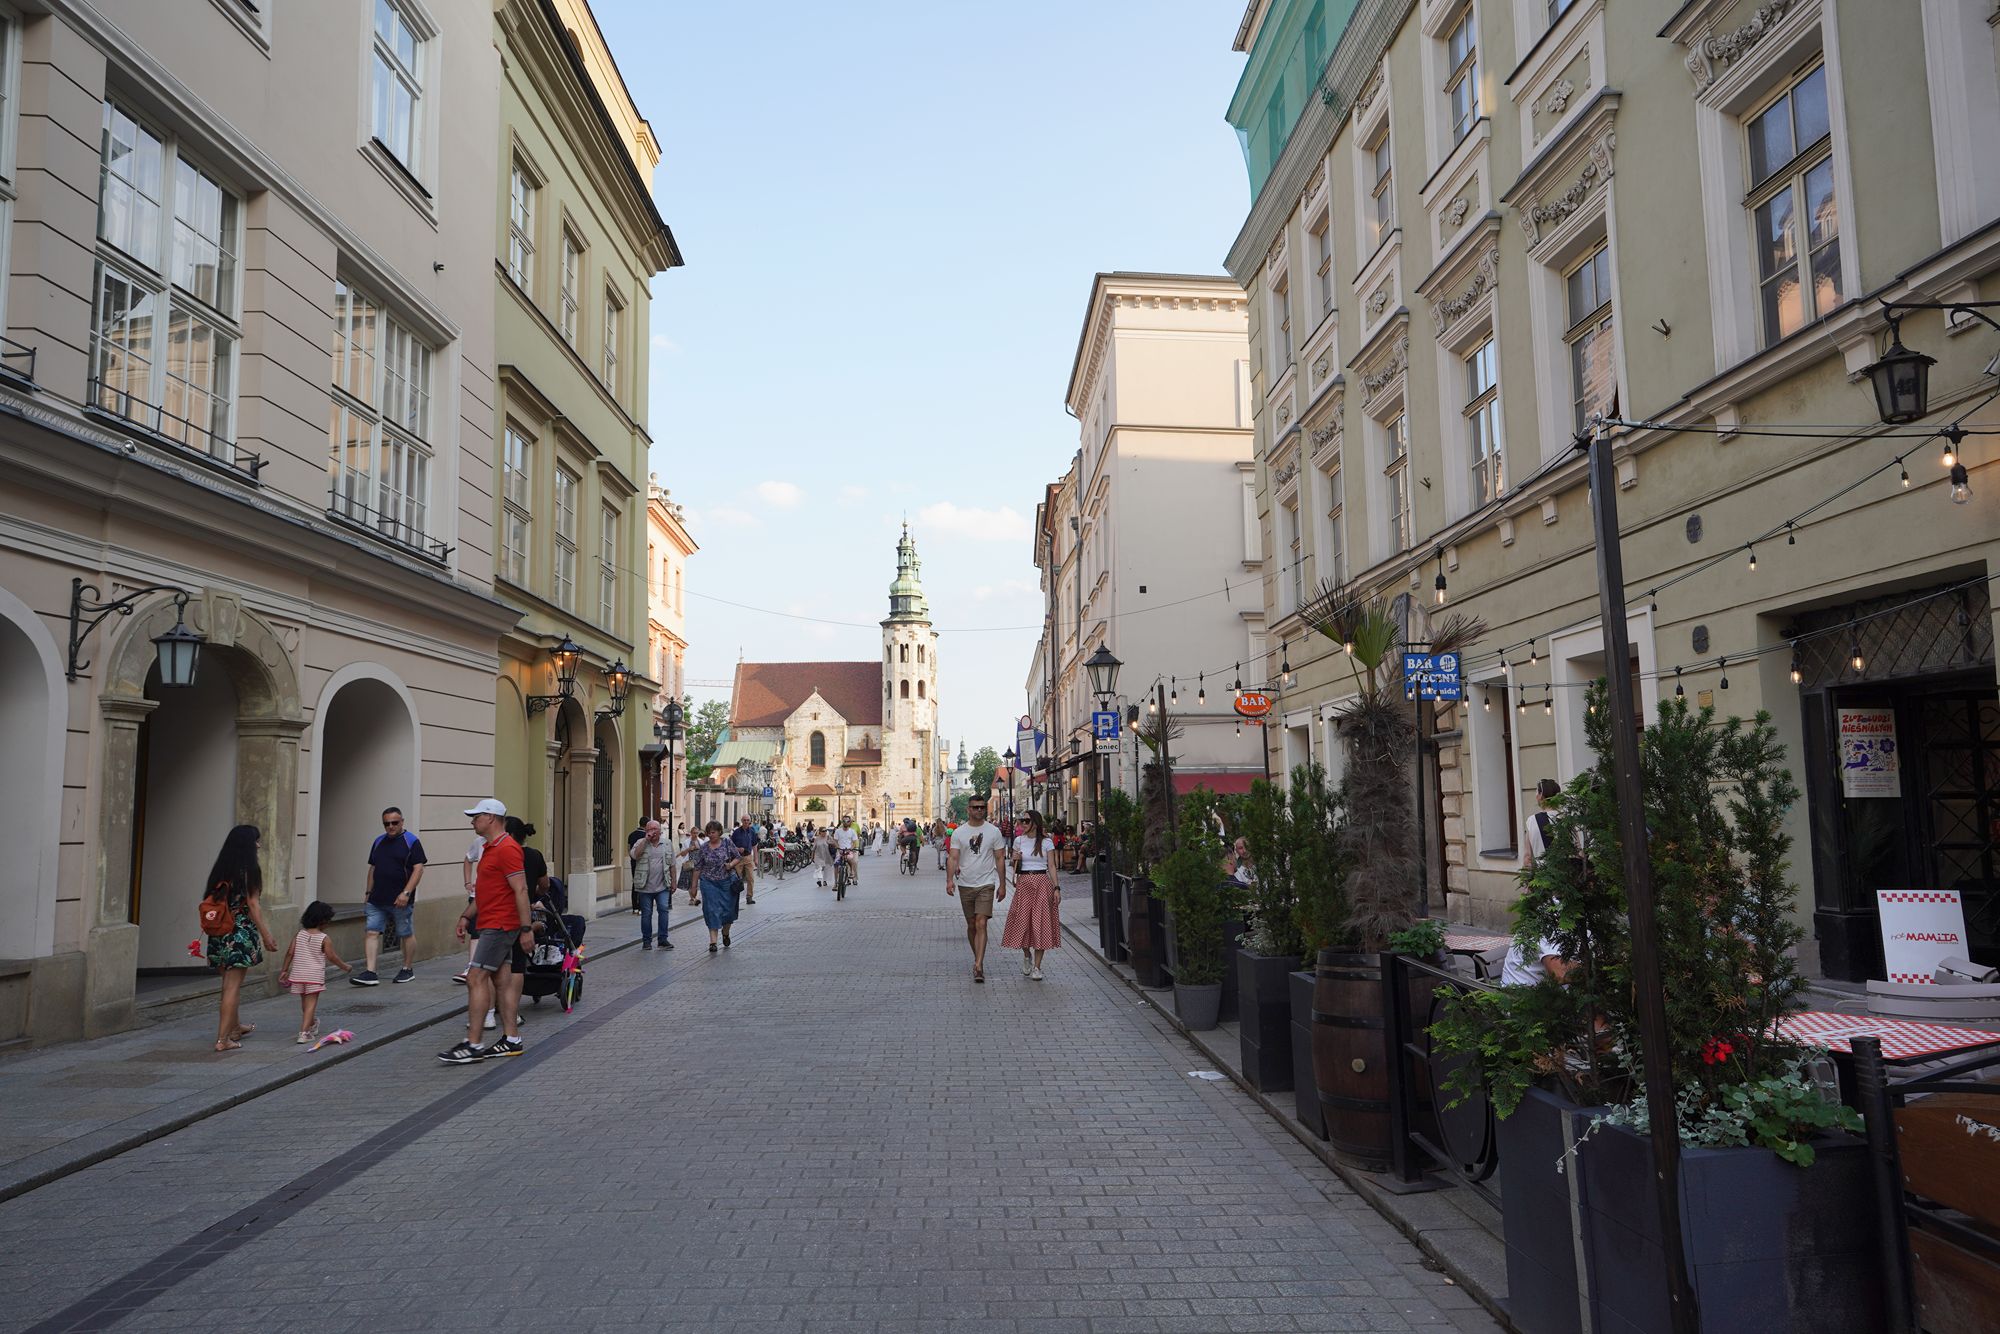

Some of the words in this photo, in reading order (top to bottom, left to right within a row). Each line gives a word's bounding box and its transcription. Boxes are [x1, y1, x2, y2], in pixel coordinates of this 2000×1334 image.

[1407, 658, 1433, 669] BAR
[1407, 673, 1458, 683] MLECZNY
[1241, 696, 1267, 706] BAR
[1097, 714, 1113, 736] P
[765, 787, 772, 796] P
